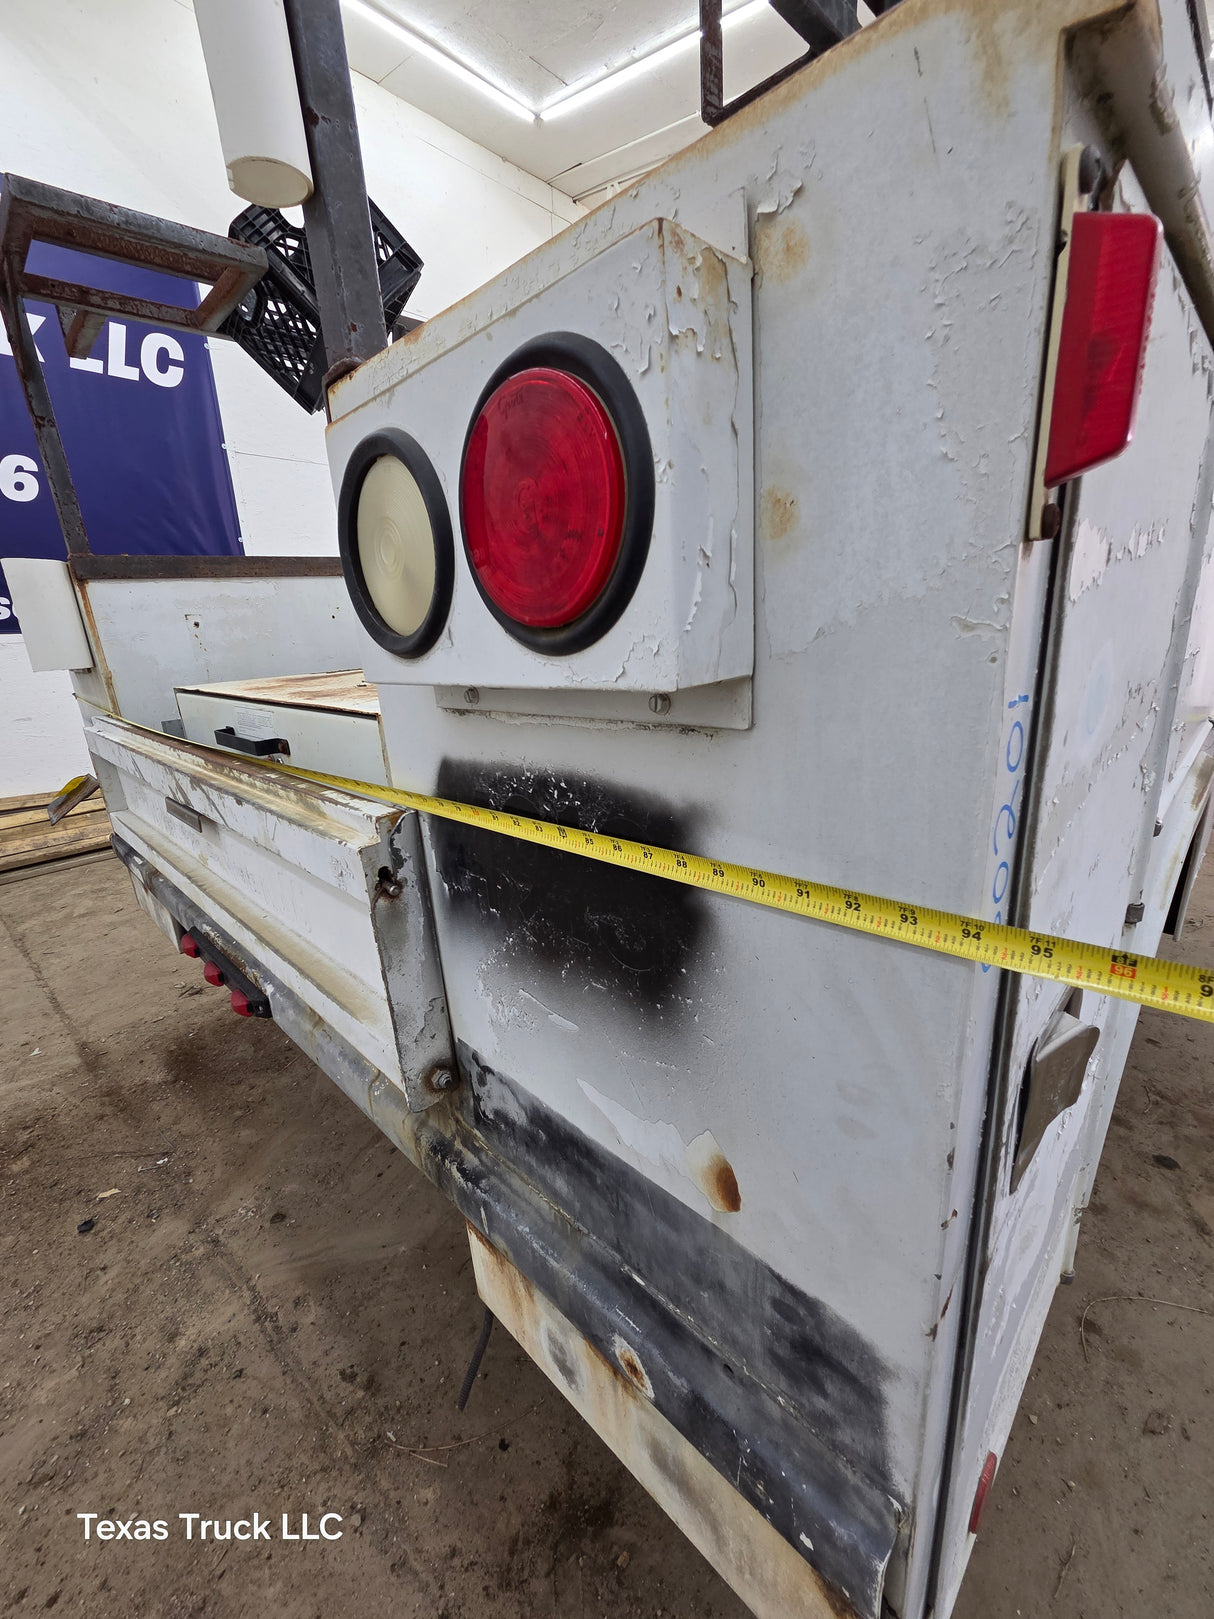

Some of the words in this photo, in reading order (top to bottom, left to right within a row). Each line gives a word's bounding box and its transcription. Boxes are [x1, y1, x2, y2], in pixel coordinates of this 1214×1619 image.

[612, 844, 622, 852] 86
[676, 859, 687, 868] 88
[712, 868, 725, 877] 89
[752, 878, 765, 888] 90
[796, 888, 810, 899] 91
[844, 900, 861, 912] 92
[900, 913, 918, 926] 93
[961, 928, 982, 941] 94
[1031, 944, 1053, 958] 95
[1113, 965, 1133, 977] 96
